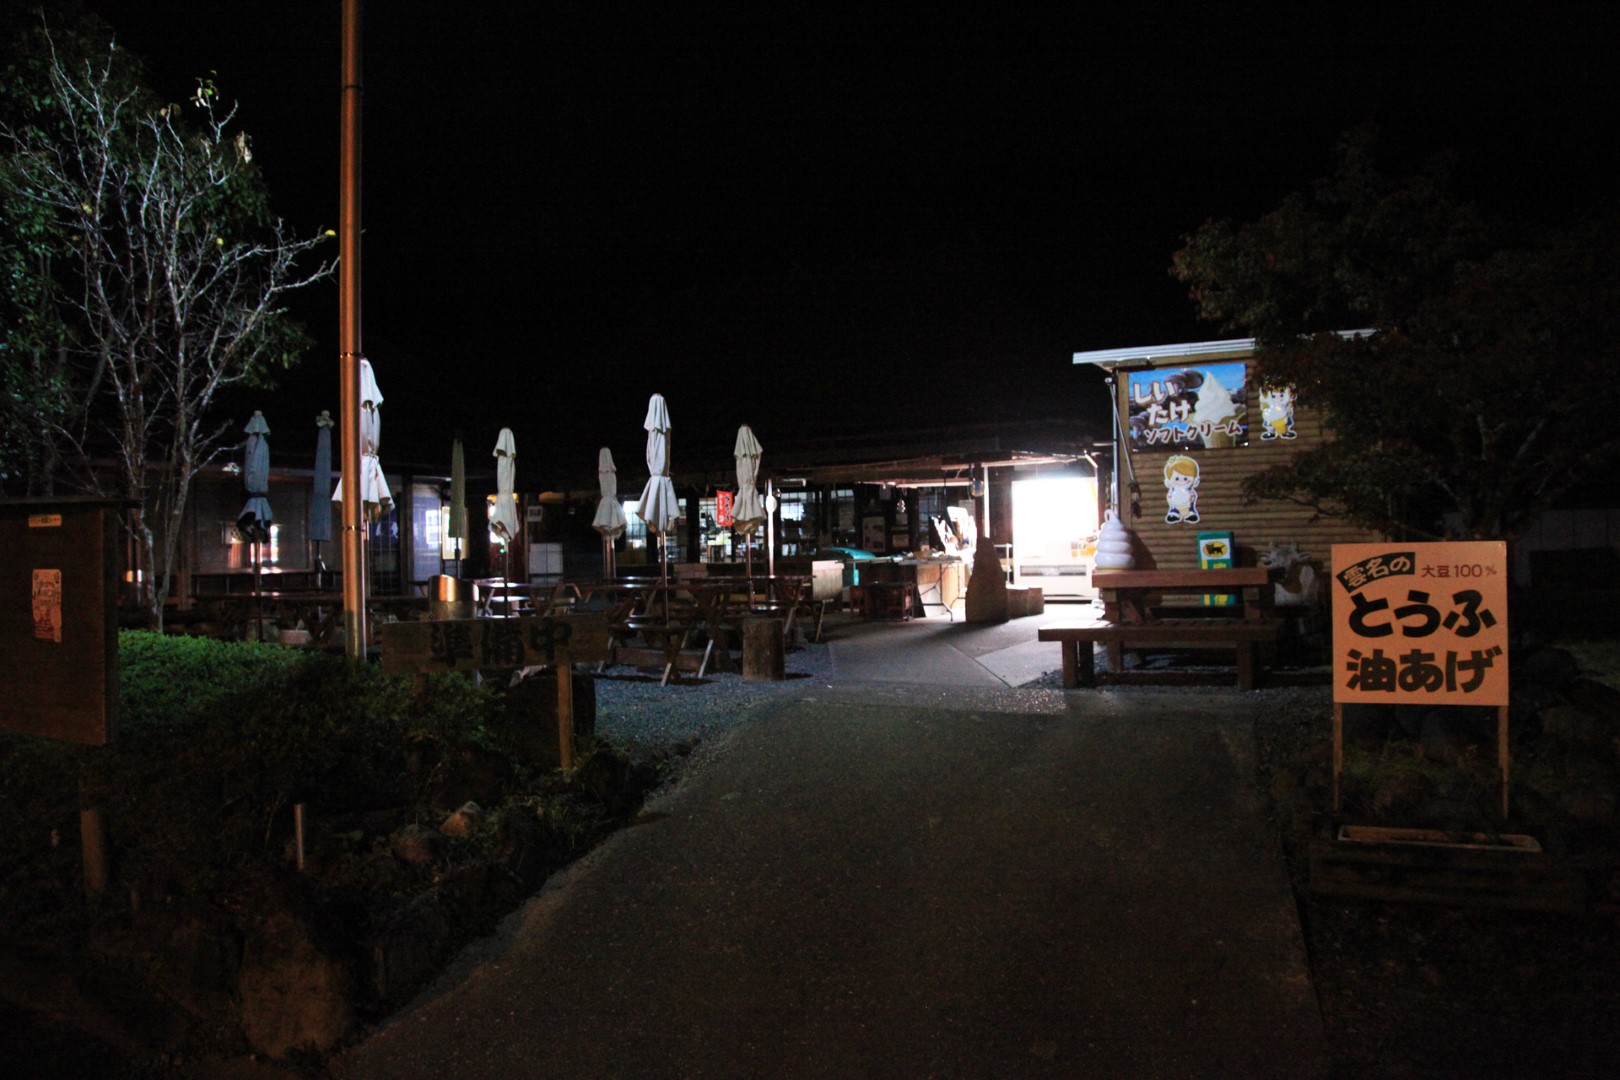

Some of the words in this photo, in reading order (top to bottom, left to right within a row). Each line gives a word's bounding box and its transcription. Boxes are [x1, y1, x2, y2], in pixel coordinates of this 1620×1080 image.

[1134, 380, 1178, 403] しい
[1147, 399, 1191, 425] たけ
[1143, 420, 1243, 445] ソフトクリーム
[1343, 556, 1411, 587] 雲名の
[1349, 590, 1497, 638] とうふ
[430, 617, 573, 667] 準備中
[1346, 645, 1503, 693] 油あげ
